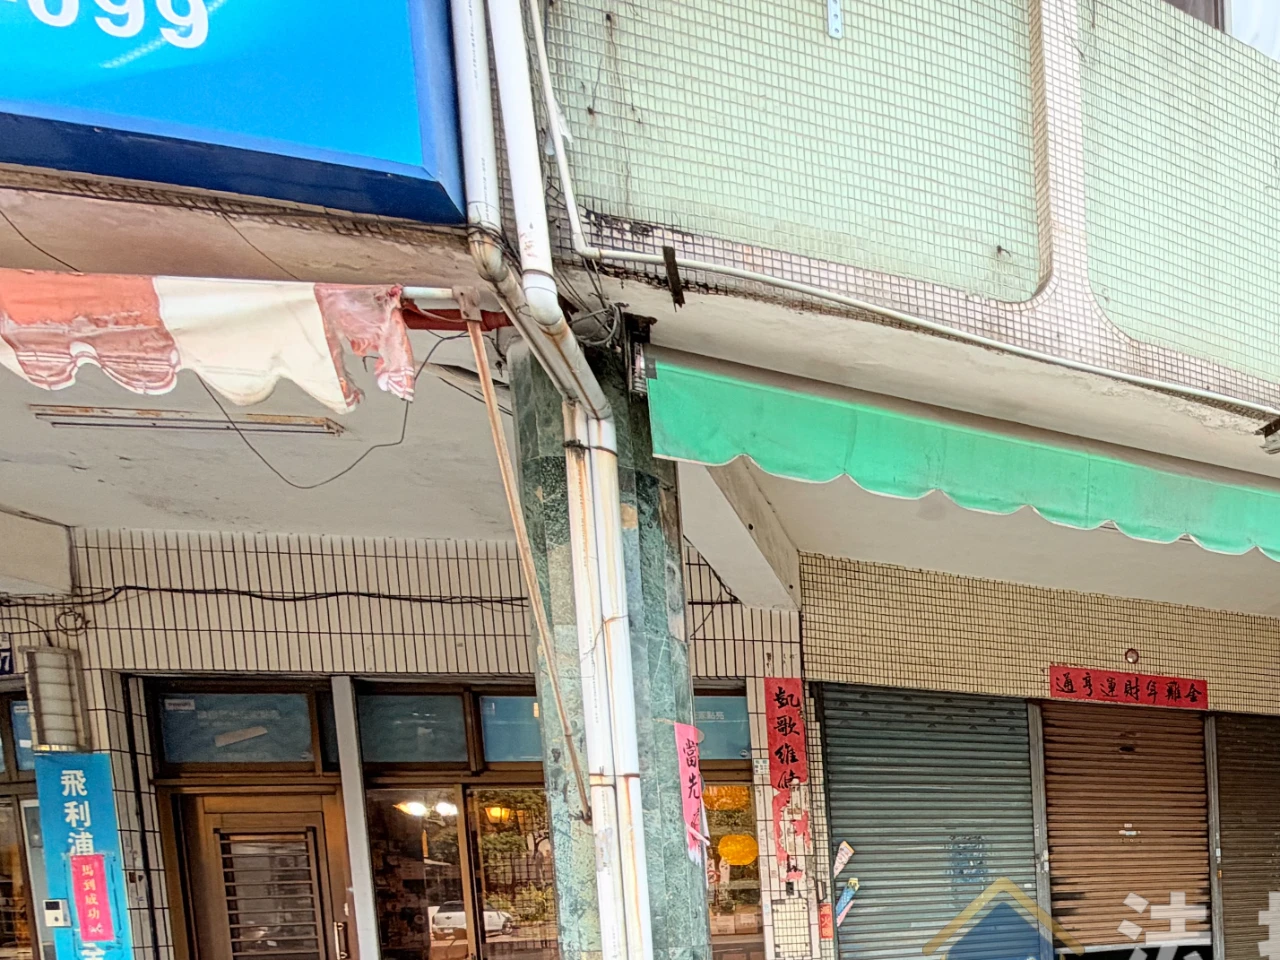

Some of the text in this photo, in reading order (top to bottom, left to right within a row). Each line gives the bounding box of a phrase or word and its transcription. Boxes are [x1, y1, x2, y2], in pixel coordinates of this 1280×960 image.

[61, 769, 94, 856] 飛利浦
[81, 864, 101, 920] 馬到成功
